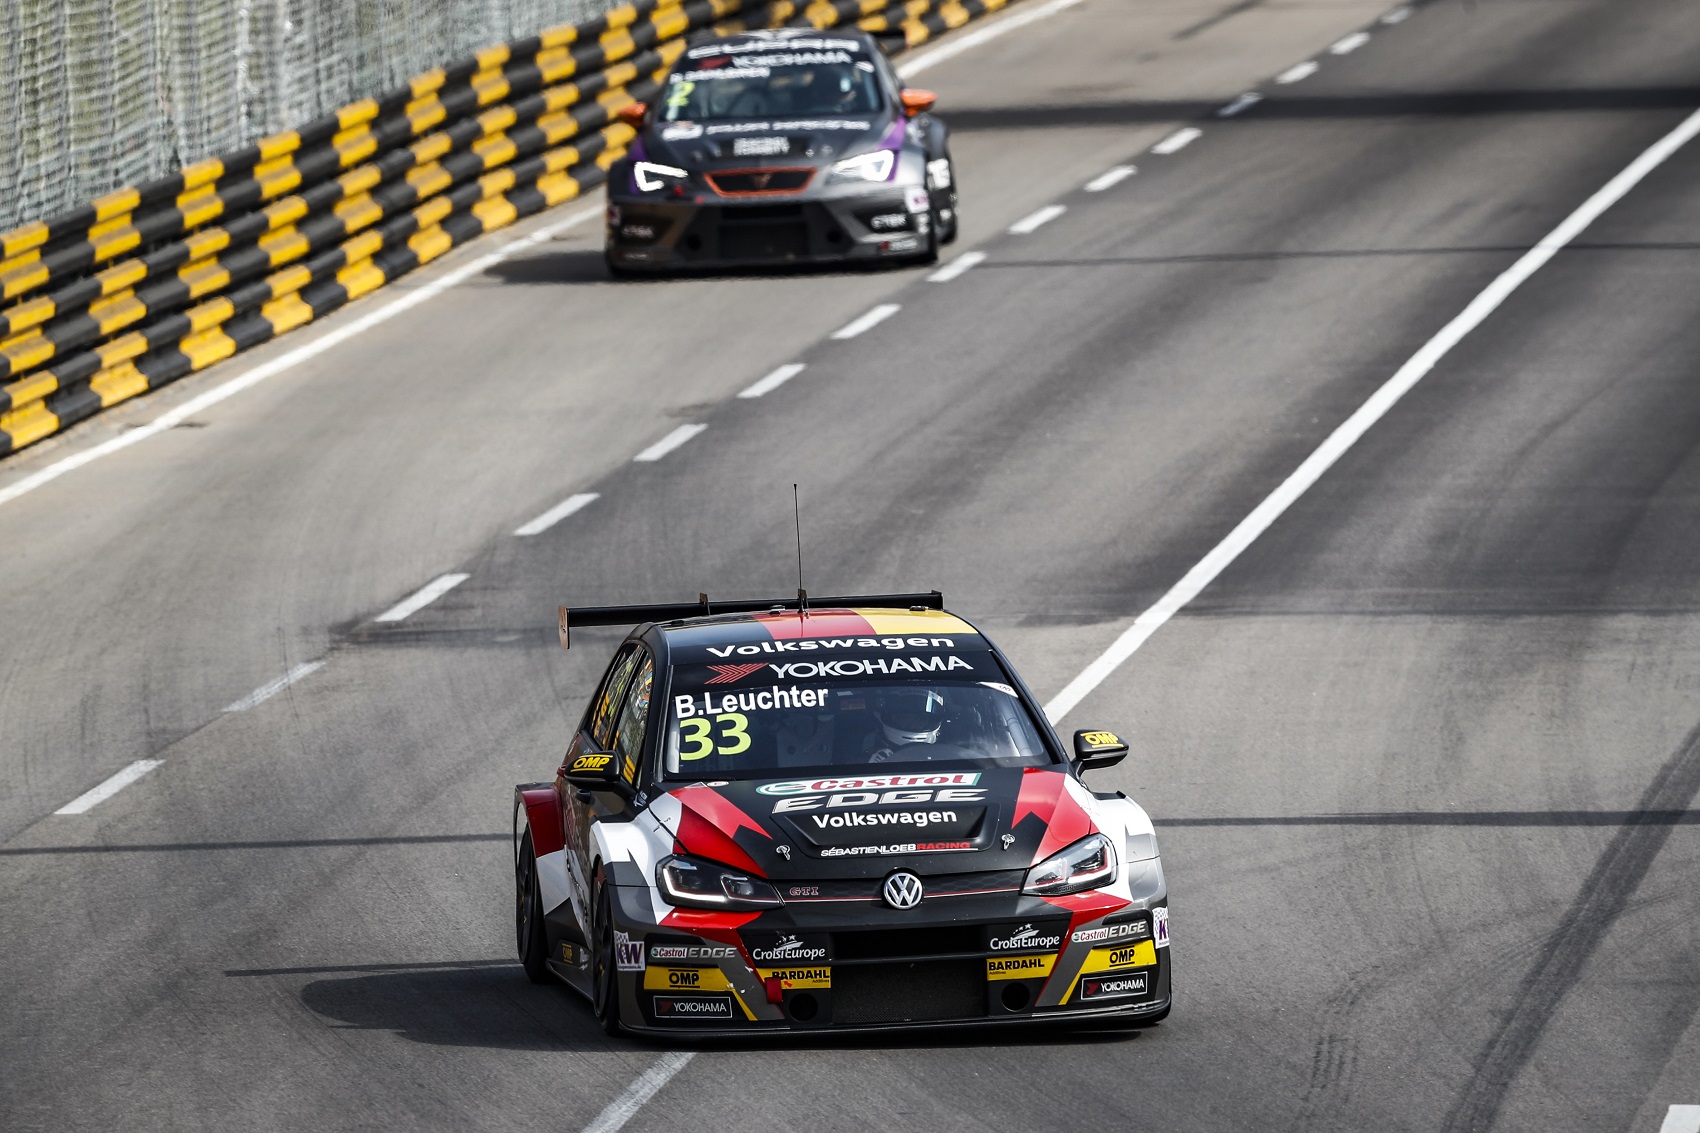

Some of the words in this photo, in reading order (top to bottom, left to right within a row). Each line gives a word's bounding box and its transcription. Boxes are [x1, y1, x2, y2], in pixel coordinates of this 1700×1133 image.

[706, 636, 954, 658] Volkswagen
[769, 655, 973, 679] YOKOHAMA
[674, 686, 829, 719] B.Leuchter
[679, 712, 752, 761] 33
[1085, 732, 1119, 745] OMP
[573, 757, 610, 769] OMP
[811, 774, 967, 790] Castrol
[772, 788, 988, 814] EDGE
[812, 810, 957, 829] Volkswagen
[789, 886, 819, 896] GTI
[1080, 929, 1107, 942] Castrol
[1108, 920, 1147, 938] EDGE
[616, 943, 643, 965] KW
[659, 947, 686, 958] Castrol
[687, 947, 738, 959] EDGE
[1109, 948, 1135, 964] OMP
[988, 958, 1045, 971] BARDAHL
[668, 972, 700, 985] OMP
[1100, 978, 1145, 992] YOKOHAMA
[673, 1002, 727, 1012] YOKOHAMA
